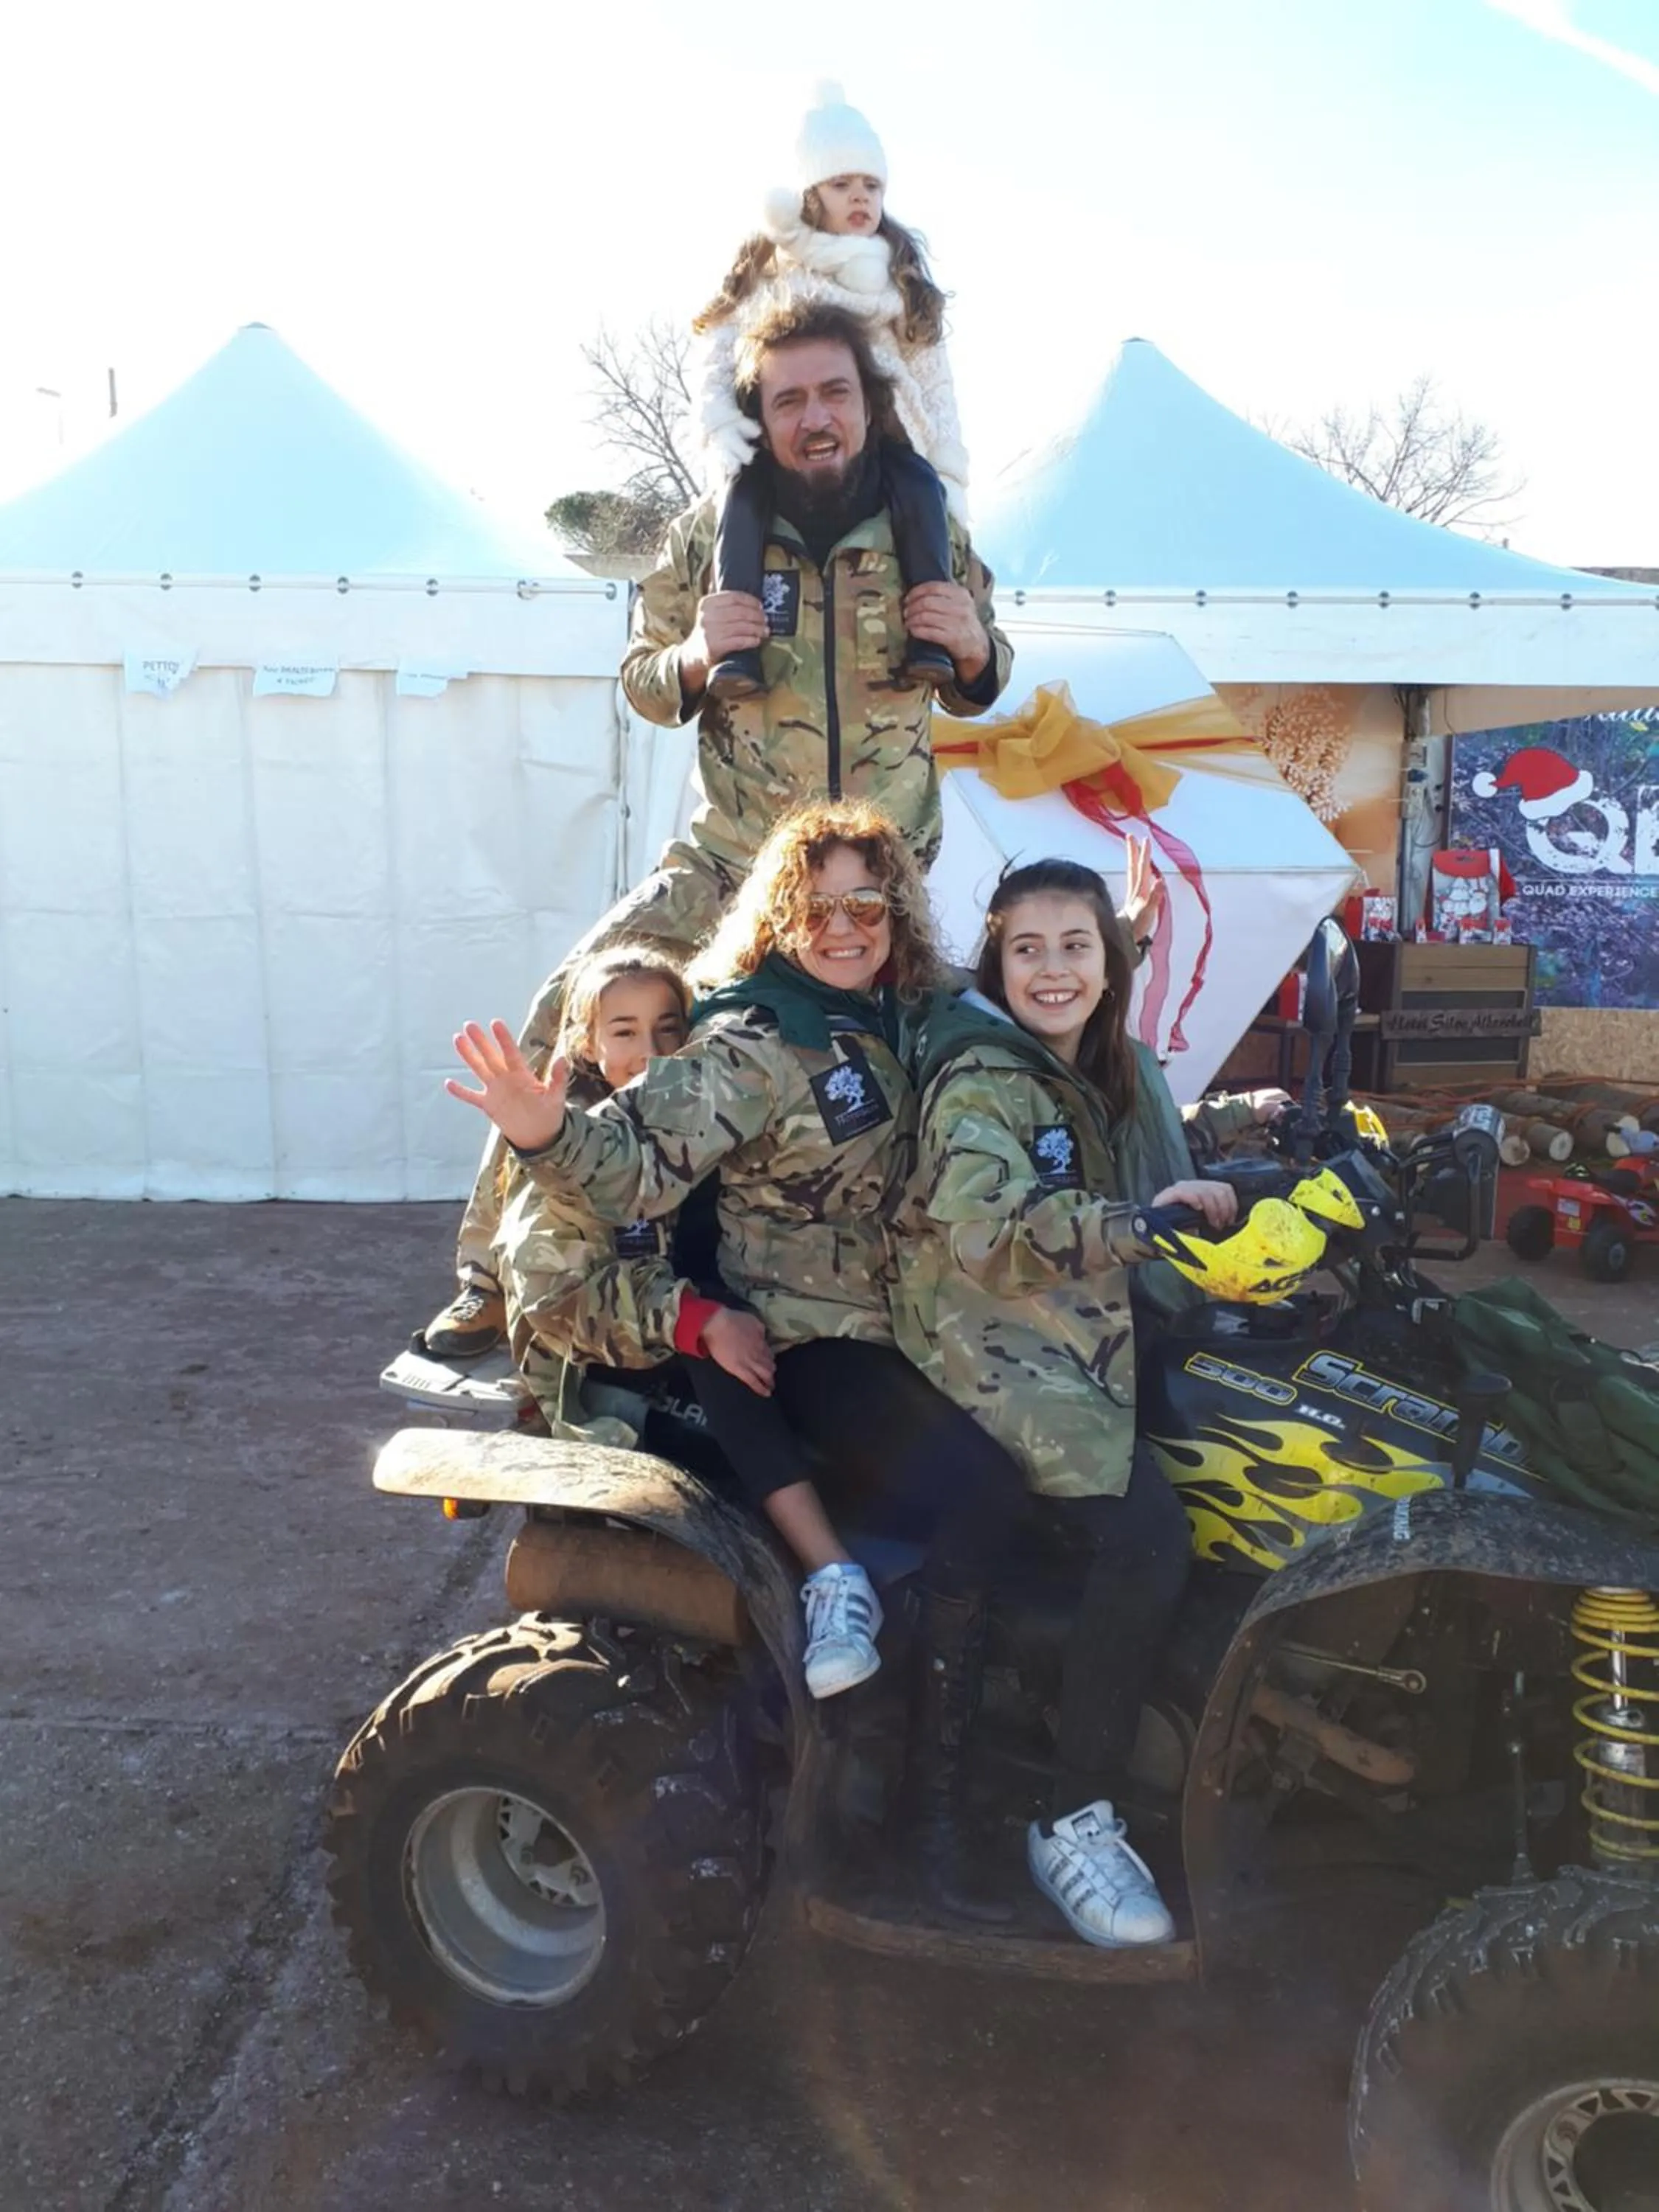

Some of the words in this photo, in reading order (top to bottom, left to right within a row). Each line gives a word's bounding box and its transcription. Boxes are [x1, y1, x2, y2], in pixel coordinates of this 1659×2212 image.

[1523, 884, 1565, 897] QUAD
[1568, 886, 1659, 899] EXPERIENCE
[1186, 1354, 1295, 1403] 500
